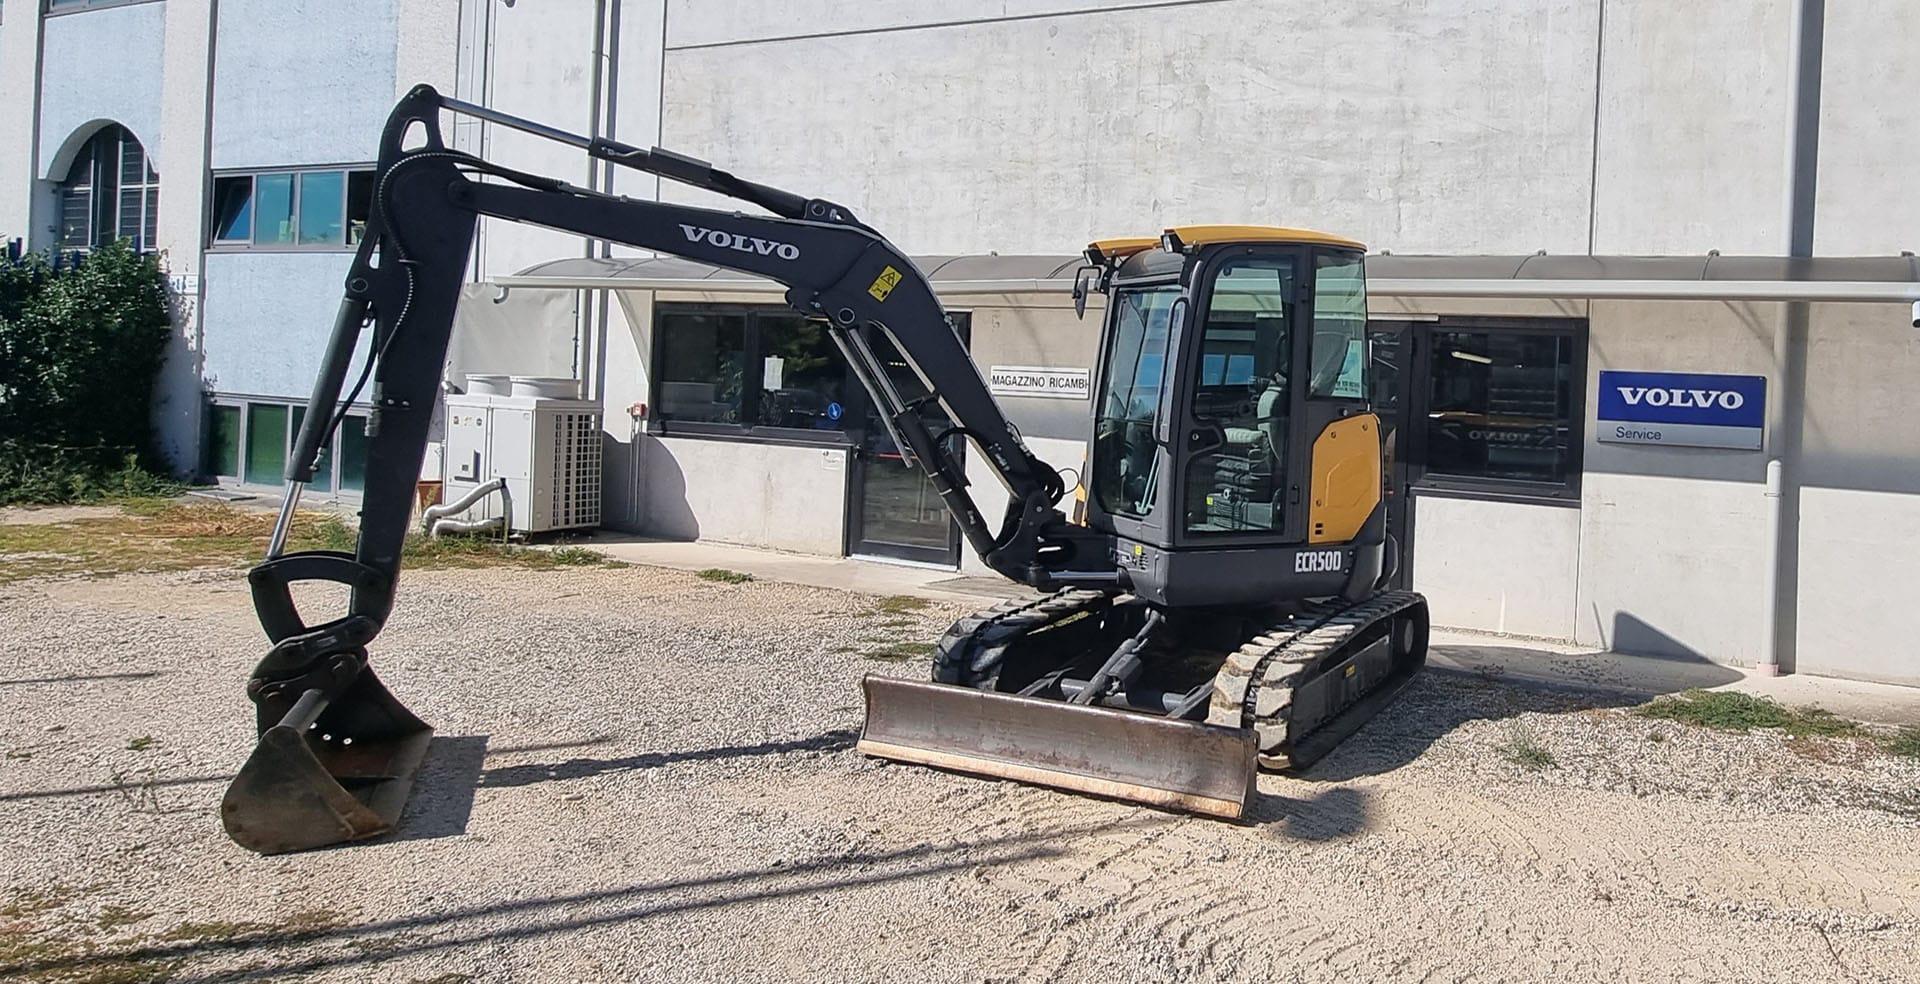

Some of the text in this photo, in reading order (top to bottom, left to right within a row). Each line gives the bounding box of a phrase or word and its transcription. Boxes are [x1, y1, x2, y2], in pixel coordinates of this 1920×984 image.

[678, 223, 800, 260] VOLVO
[992, 375, 1046, 388] MAGAZZINO
[1616, 386, 1744, 410] VOLVO
[1615, 426, 1662, 440] Service
[1295, 551, 1342, 573] ECR50D
